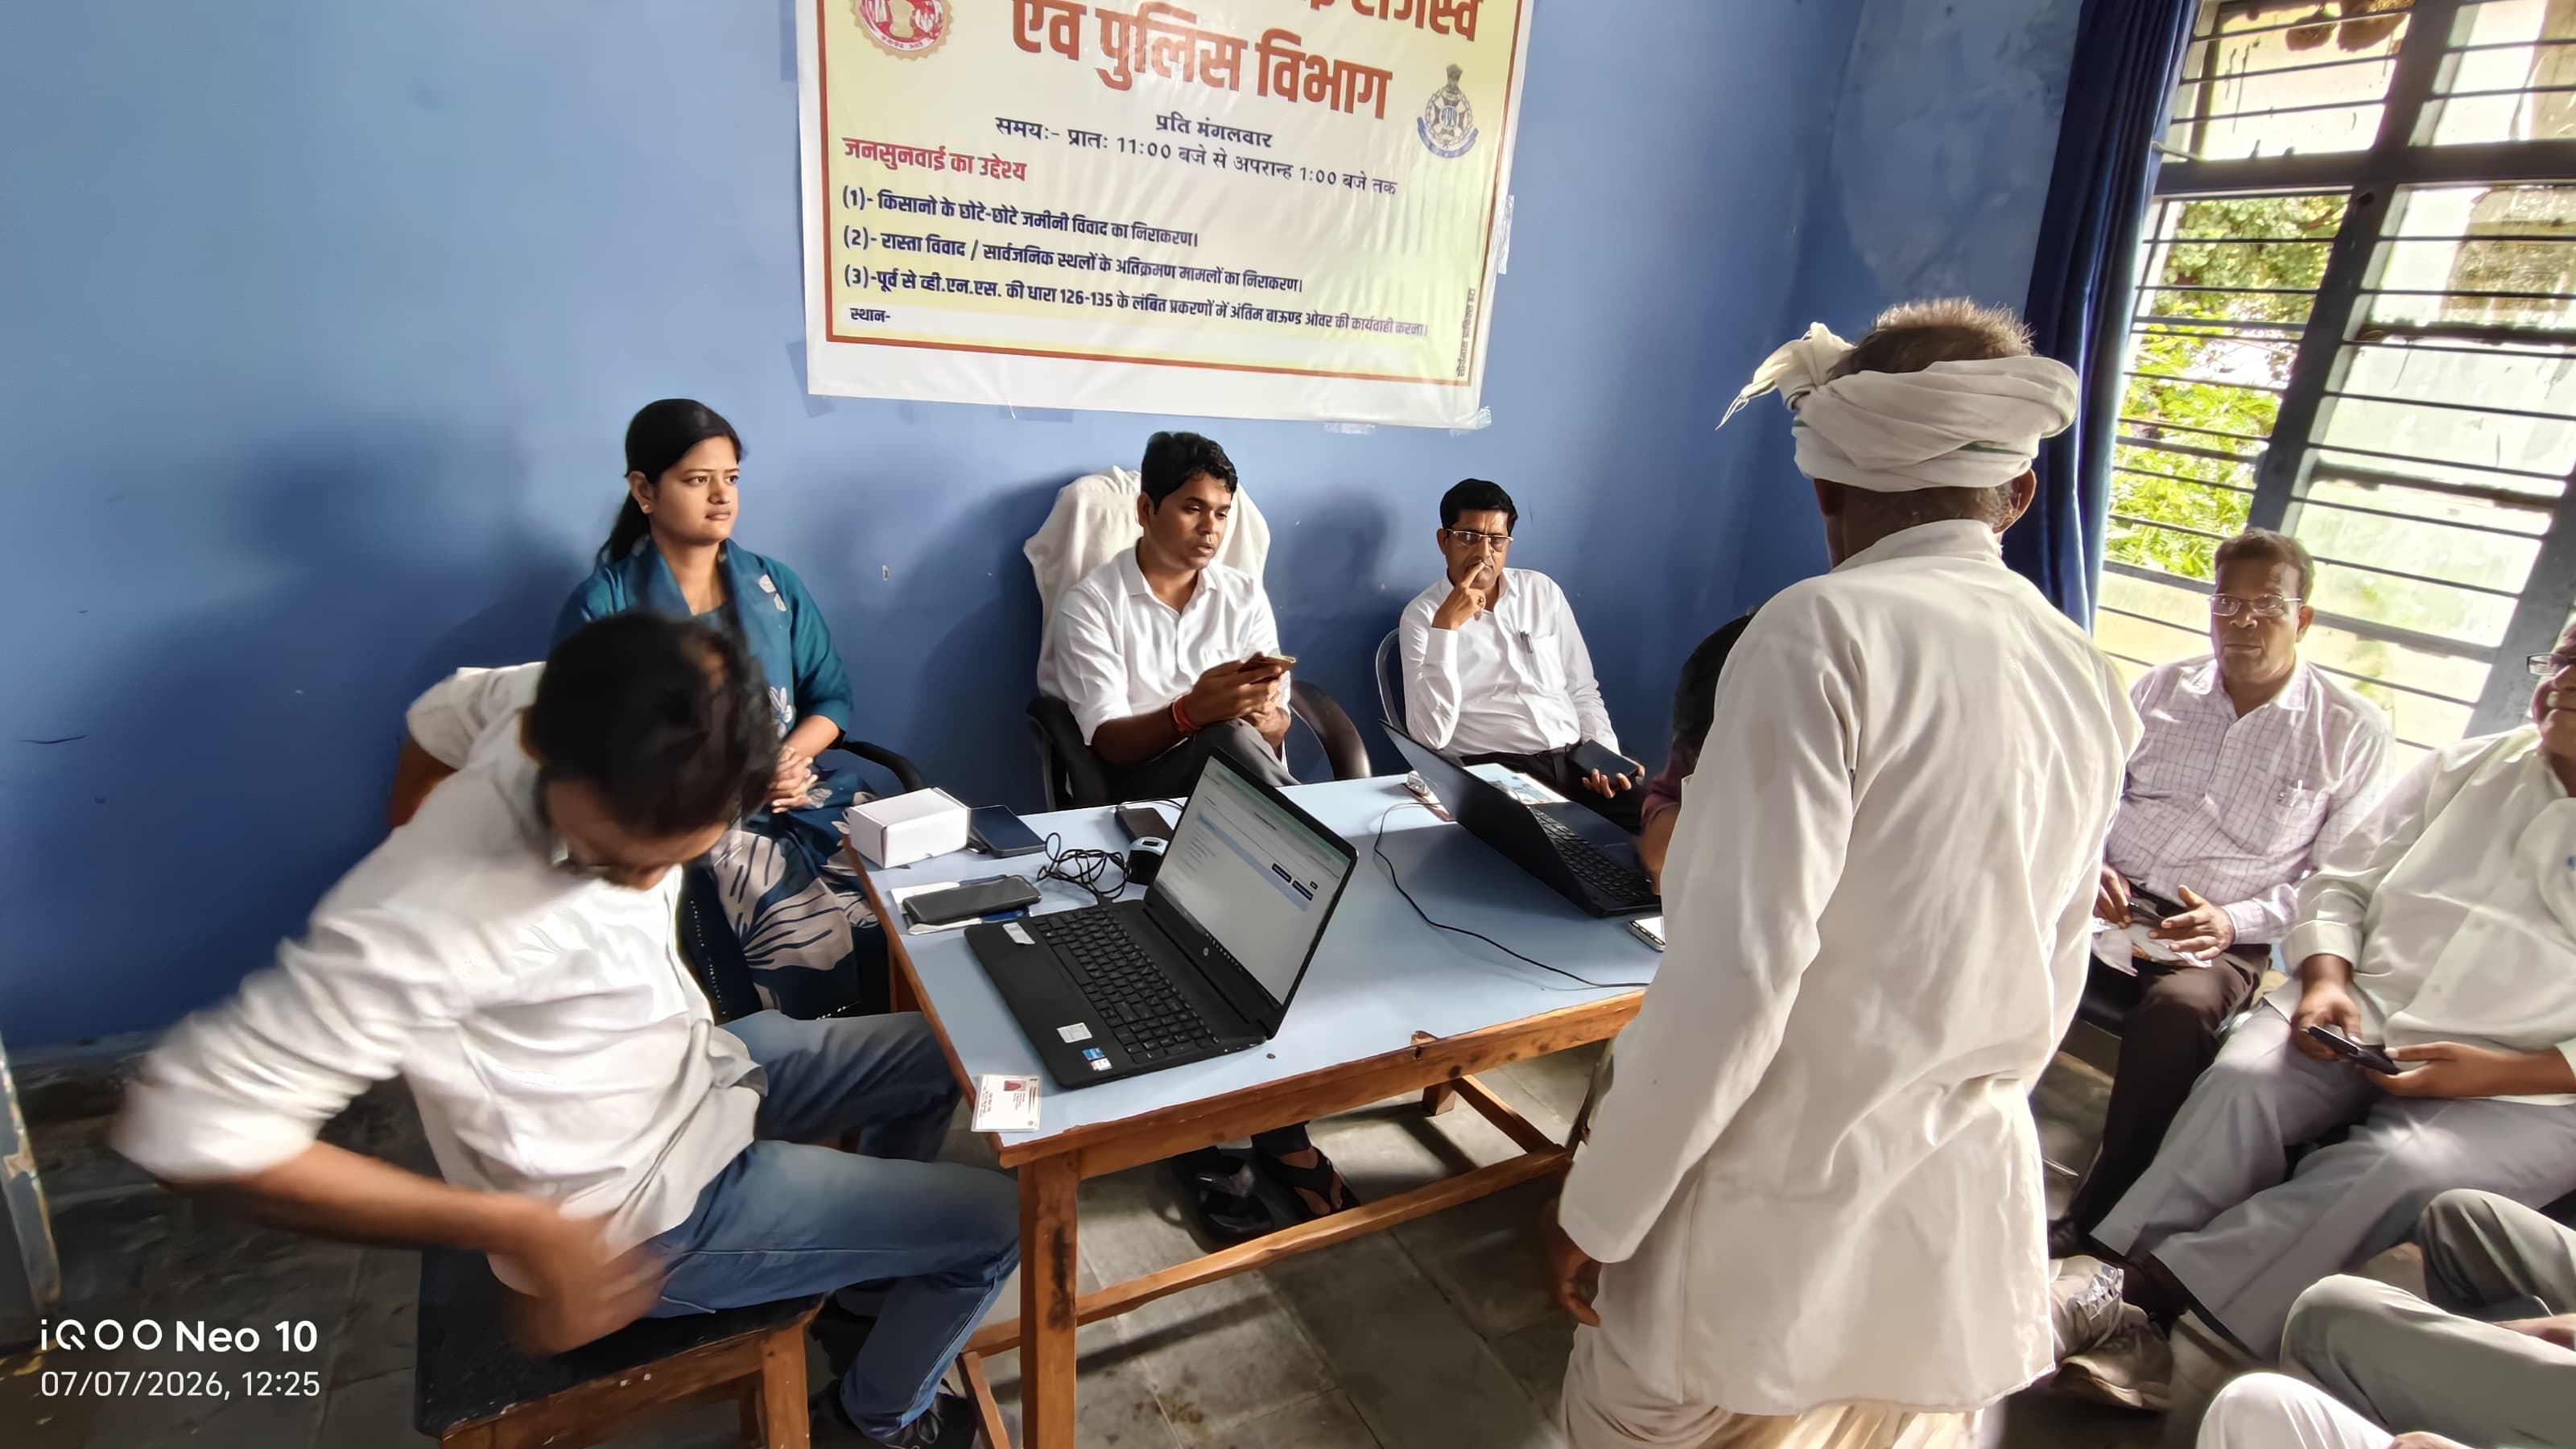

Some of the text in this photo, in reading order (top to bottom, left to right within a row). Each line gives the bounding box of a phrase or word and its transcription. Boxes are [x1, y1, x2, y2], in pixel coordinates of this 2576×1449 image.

[1094, 1, 1249, 91] पुलिस
[1255, 27, 1393, 119] विभाग
[842, 137, 1028, 182] जनसुनवाई का उद्देश्य
[1156, 111, 1273, 148] प्रति मंगलवार
[1117, 137, 1171, 159] 11:00
[1179, 144, 1207, 166] बजे
[1212, 147, 1228, 168] से
[1233, 155, 1294, 180] अपरान्ह
[1299, 167, 1336, 185] 1:00
[1343, 171, 1367, 191] बजे
[1372, 179, 1398, 196] तक
[843, 185, 1199, 248] (1)- किसानो के छोटे-छोटे जमीनी विवाद का निराकरण।
[844, 225, 877, 250] (2)-
[880, 232, 923, 253] रास्ता
[925, 233, 967, 257] विवाद
[982, 242, 1055, 266] सार्वजनिक
[1058, 251, 1097, 270] स्थलों
[1099, 253, 1113, 272] के
[1116, 256, 1176, 279] अतिक्रमण
[1178, 266, 1224, 284] मामलों
[1224, 270, 1241, 286] का
[1242, 269, 1303, 293] निराकरण।
[901, 269, 917, 290] से
[1005, 280, 1025, 299] की
[1026, 286, 1058, 303] धारा
[1060, 289, 1113, 308] 126-135
[1116, 290, 1131, 309] के
[1132, 293, 1167, 312] लंबित
[1169, 299, 1215, 316] प्रकरणों
[1215, 300, 1229, 318] में
[1230, 303, 1265, 321] अंतिम
[1265, 308, 1302, 325] बाऊण्ड
[1305, 310, 1334, 328] ओवर
[1335, 312, 1350, 329] की
[1352, 316, 1393, 334] कार्यवाही
